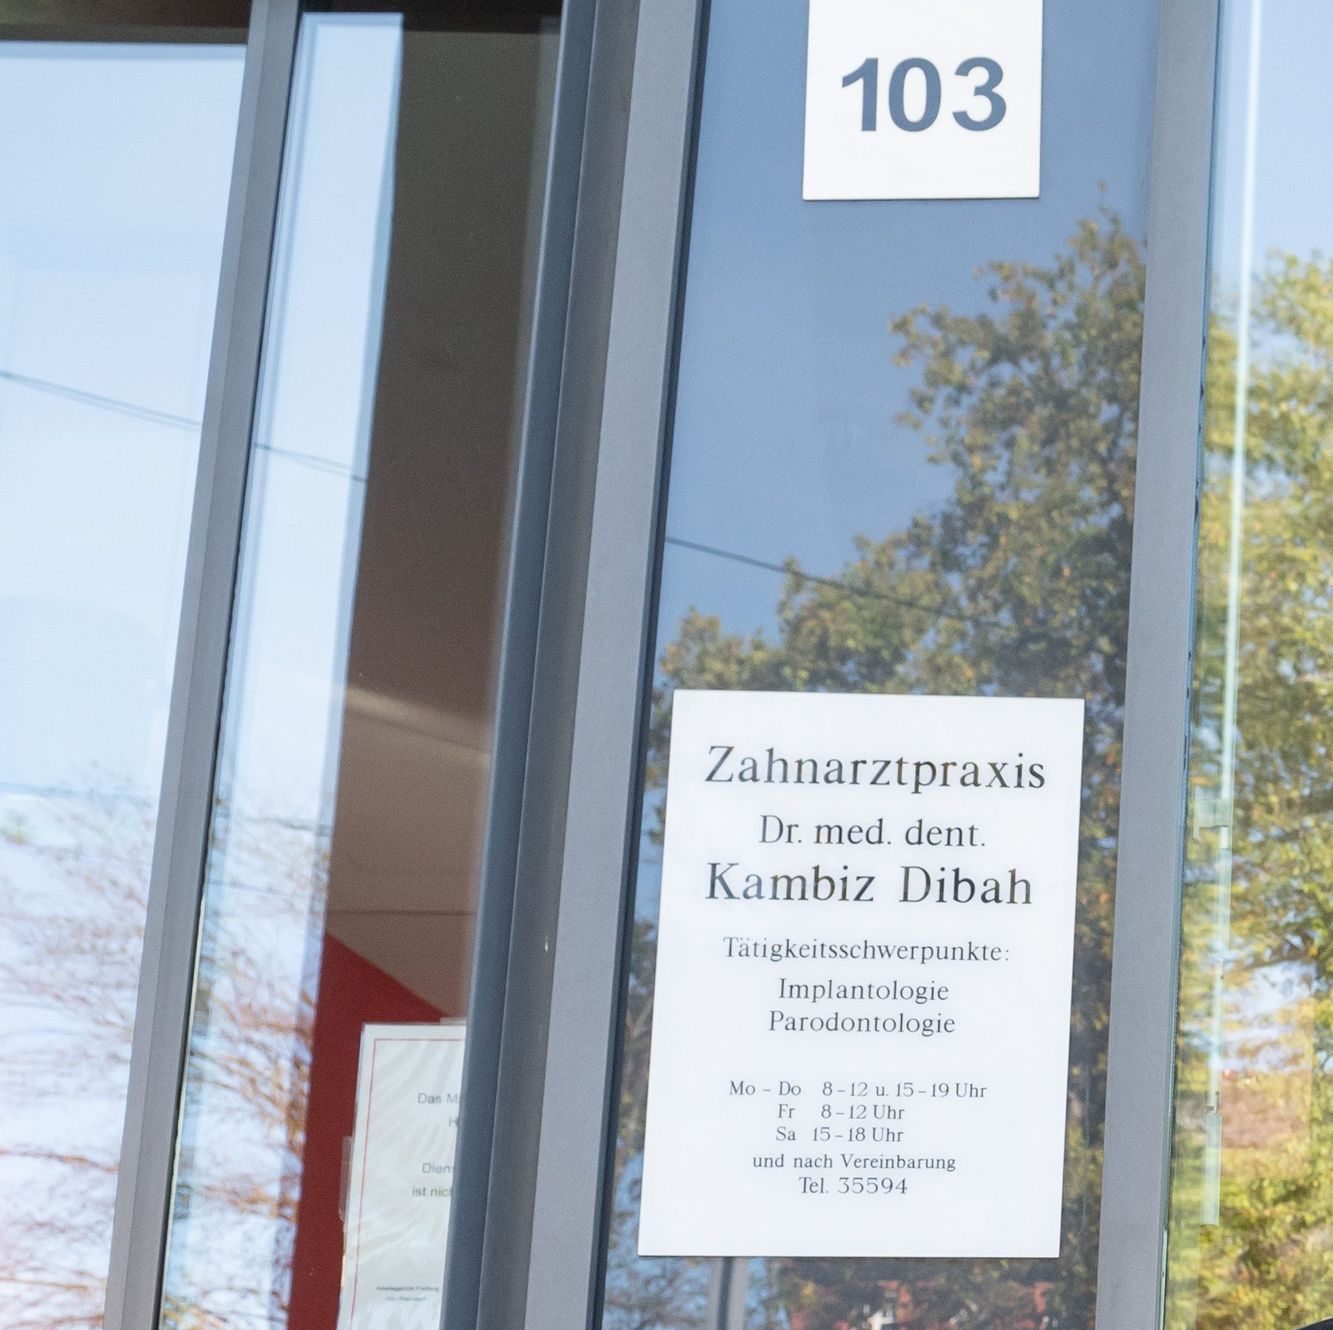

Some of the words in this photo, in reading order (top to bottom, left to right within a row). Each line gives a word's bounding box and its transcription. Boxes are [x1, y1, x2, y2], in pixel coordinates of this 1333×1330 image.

[841, 56, 1007, 133] 103
[705, 745, 1046, 794] Zahnarztpraxis
[759, 814, 802, 844] Dr.
[813, 817, 892, 845] med.
[904, 818, 986, 847] dent.
[705, 862, 876, 901] Kambiz
[898, 865, 1032, 905] Dibah
[723, 936, 1011, 965] Tätigkeitsschwerpunkte:
[778, 977, 950, 1003] Implantologie
[769, 1010, 956, 1038] Parodontologie
[729, 1081, 756, 1096] Mo
[778, 1081, 802, 1097] Do
[875, 1085, 890, 1098] u.
[955, 1082, 988, 1098] Uhr
[777, 1103, 796, 1119] Fr
[872, 1104, 905, 1120] Uhr
[775, 1126, 797, 1142] Sa
[871, 1126, 904, 1143] Uhr
[752, 1153, 785, 1169] und
[793, 1153, 833, 1169] nach
[840, 1153, 957, 1173] Vereinbarung
[798, 1176, 830, 1194] Tel.
[838, 1176, 908, 1195] 35594
